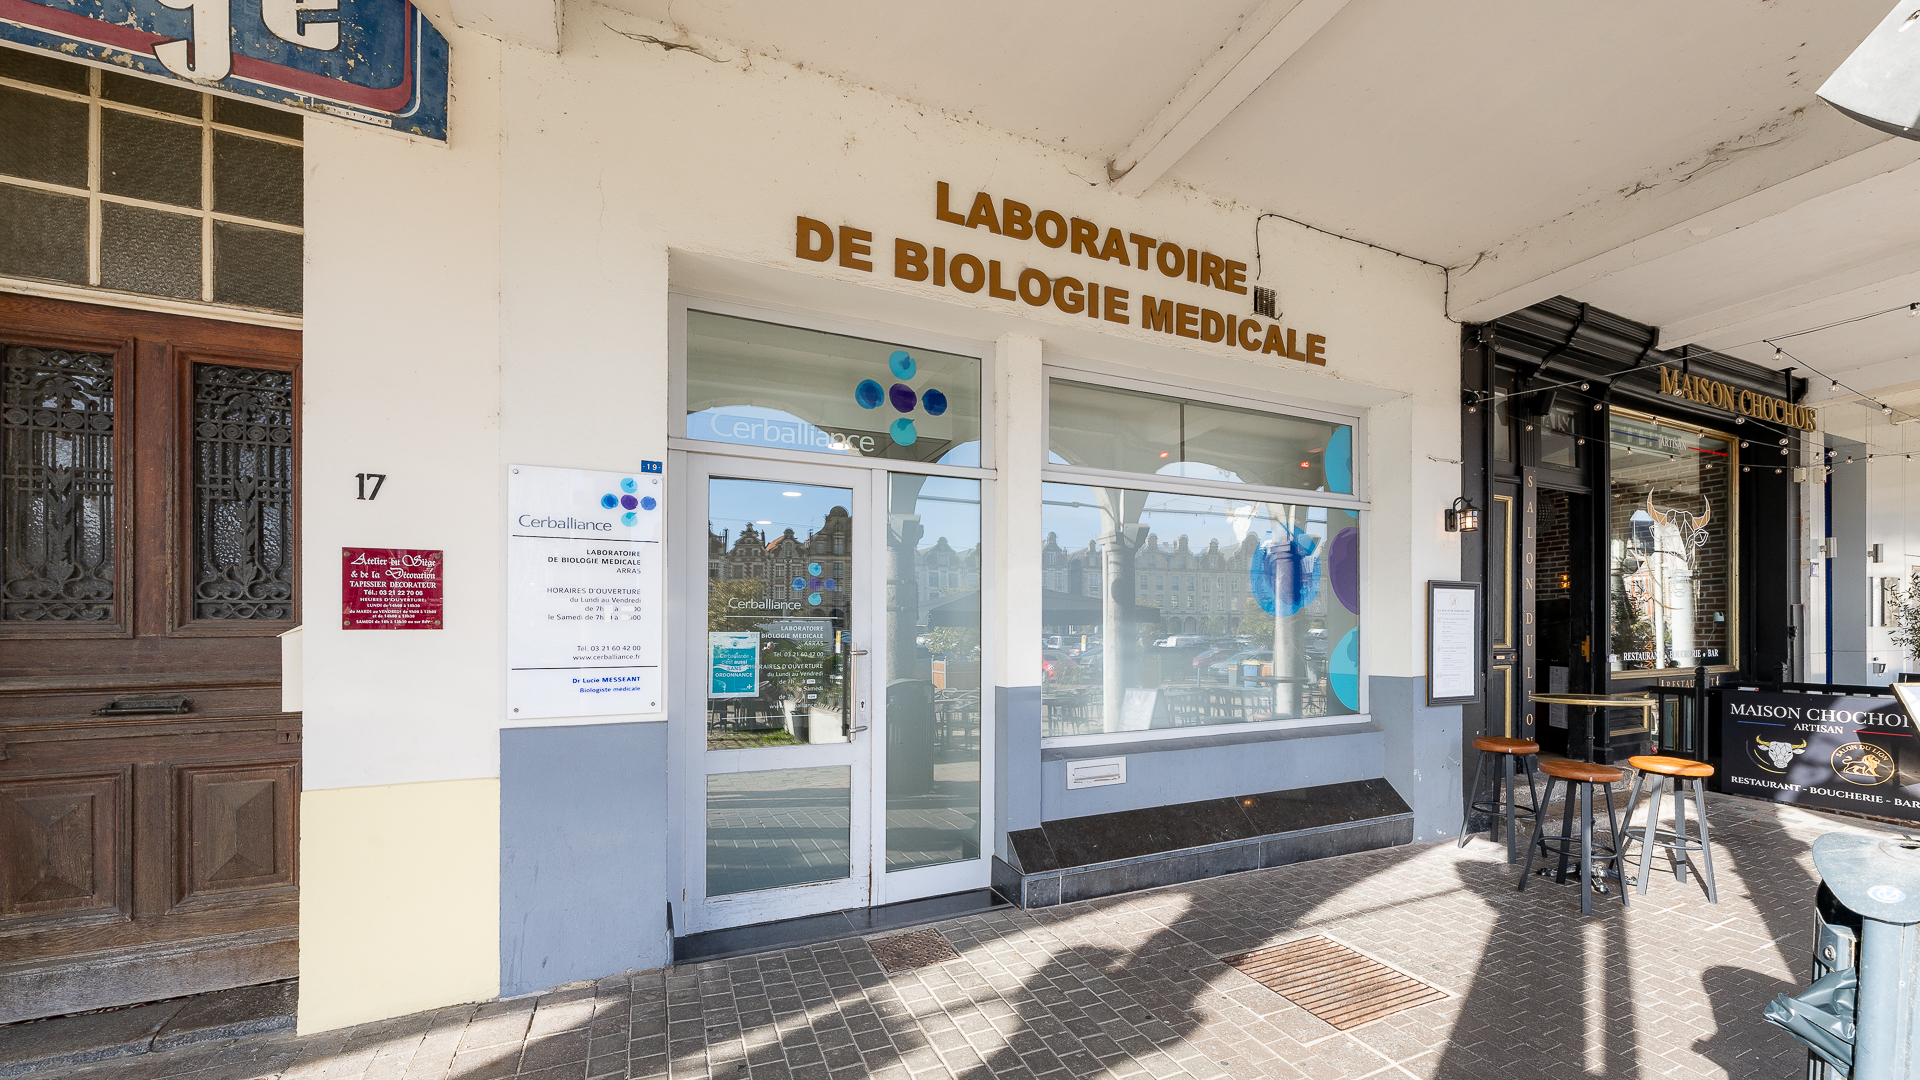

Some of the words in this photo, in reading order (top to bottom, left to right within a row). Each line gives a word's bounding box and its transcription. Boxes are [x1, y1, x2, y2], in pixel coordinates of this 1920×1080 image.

[936, 180, 1247, 295] LABORATOIRE
[796, 215, 872, 272] DE
[894, 237, 1130, 324] BIOLOGIE
[1142, 295, 1326, 366] MEDICALE
[1660, 366, 1735, 412] MAISON
[1738, 390, 1817, 432] CHOCHOIS
[710, 412, 875, 452] Cerballiance
[1660, 437, 1687, 451] ARTISAN
[646, 462, 658, 471] 19
[355, 472, 386, 500] 17
[518, 514, 612, 531] Cerballiance
[1526, 475, 1534, 590] SALON
[350, 553, 387, 566] Atelier
[390, 558, 400, 566] du
[728, 598, 801, 610] Cerballiance
[1526, 612, 1534, 647] DU
[1707, 648, 1719, 657] BAR
[1730, 703, 1801, 720] MAISON
[1806, 708, 1913, 728] CHOCHOI
[1793, 723, 1843, 734] ARTISAN
[1836, 744, 1858, 758] SALON
[1872, 748, 1889, 762] LION
[1731, 775, 1801, 792] RESTAURANT
[1810, 786, 1883, 803] BOUCHERIE
[1894, 798, 1920, 809] BAR
